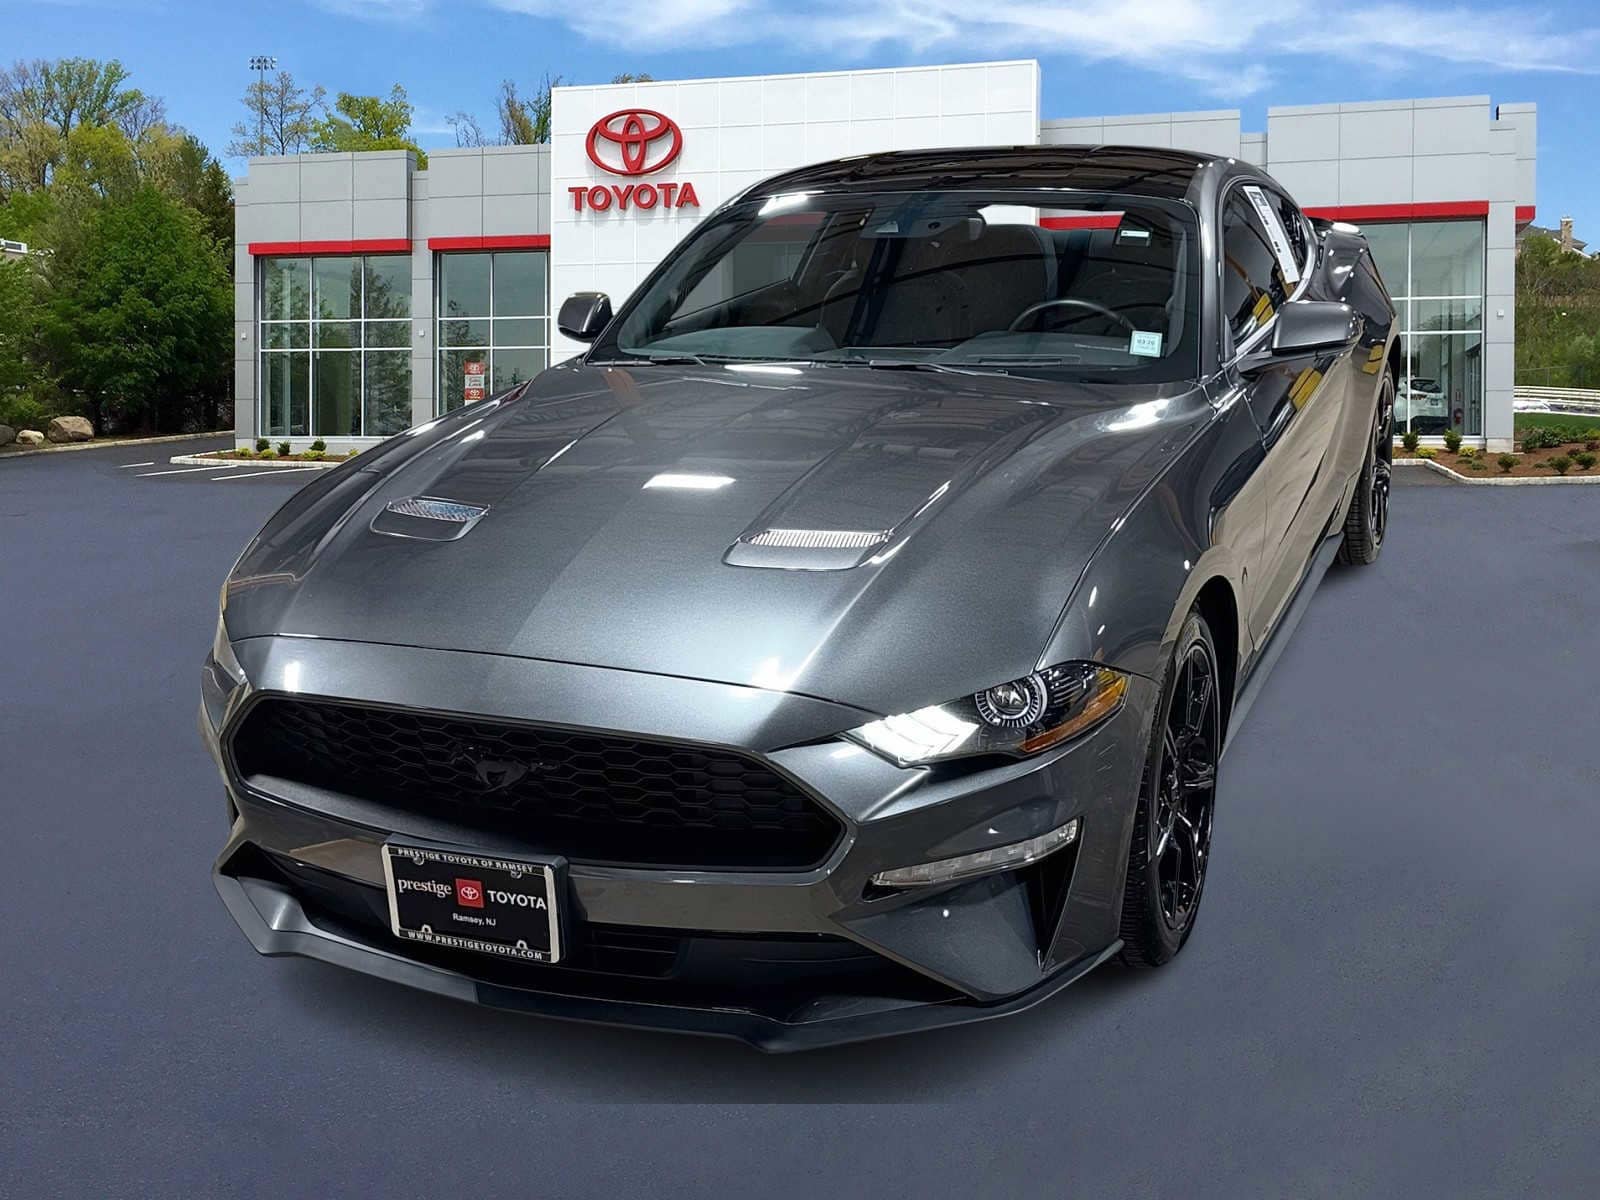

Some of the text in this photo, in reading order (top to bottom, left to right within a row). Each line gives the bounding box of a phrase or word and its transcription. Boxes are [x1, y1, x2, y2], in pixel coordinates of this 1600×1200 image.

[568, 182, 700, 211] TOYOTA
[398, 849, 440, 860] PRESTIGE
[442, 853, 479, 865] TOYOTA
[495, 862, 533, 873] RAMSEY
[398, 879, 546, 910] prestige TOYOTA
[452, 912, 496, 926] Ramsey, NJ
[408, 931, 542, 960] WWW.PRESTIGETOYOTA.COM
